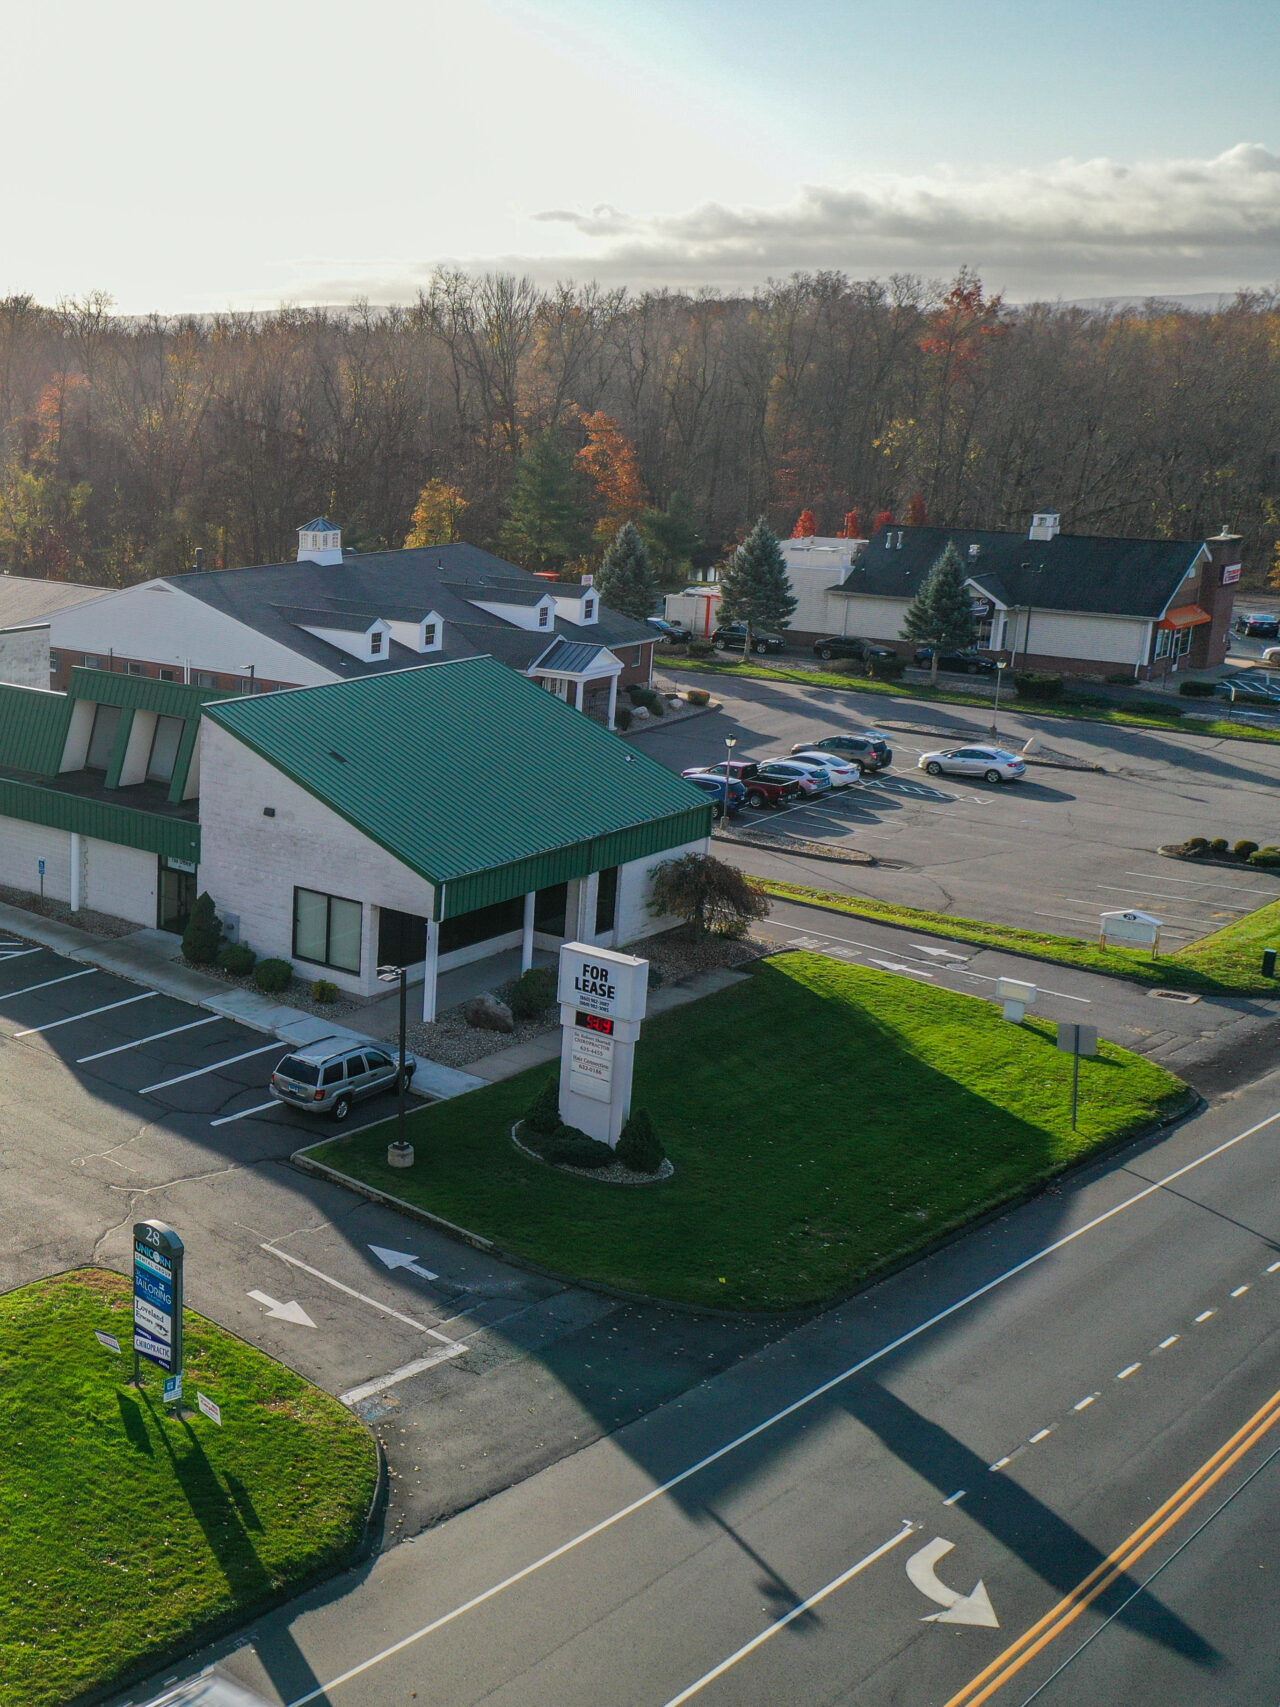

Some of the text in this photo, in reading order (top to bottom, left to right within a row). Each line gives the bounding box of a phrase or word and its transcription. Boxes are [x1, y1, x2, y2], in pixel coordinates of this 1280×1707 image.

[582, 963, 609, 983] FOR
[575, 976, 616, 1000] LEASE
[145, 1227, 160, 1246] 28
[135, 1240, 172, 1269] UNICORN
[135, 1275, 172, 1305] TAILORING
[135, 1299, 164, 1323] Loveland
[135, 1338, 170, 1358] CHIROPRACTIC
